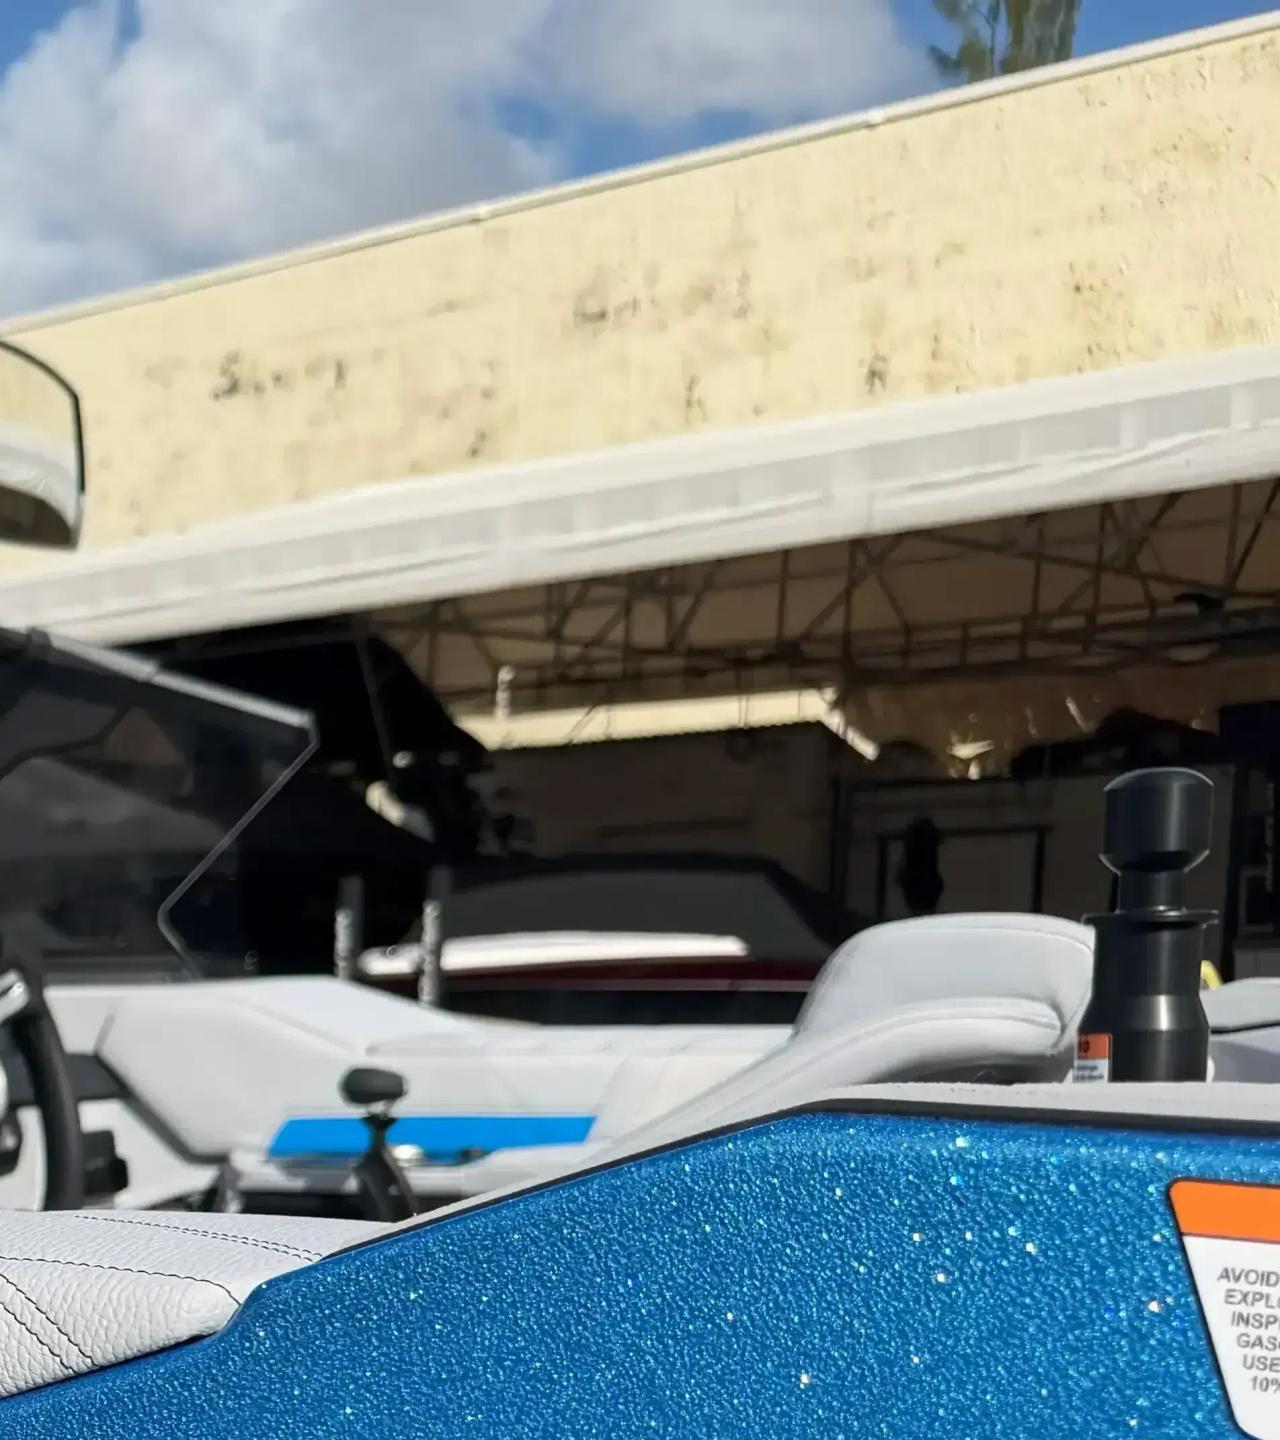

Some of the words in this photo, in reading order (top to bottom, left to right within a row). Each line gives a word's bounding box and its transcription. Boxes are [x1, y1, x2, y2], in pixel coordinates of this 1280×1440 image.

[1217, 1267, 1280, 1288] AVOID
[1224, 1288, 1280, 1310] EXPL
[1231, 1311, 1280, 1331] INSP
[1237, 1332, 1280, 1353] GAS
[1242, 1353, 1280, 1374] USE
